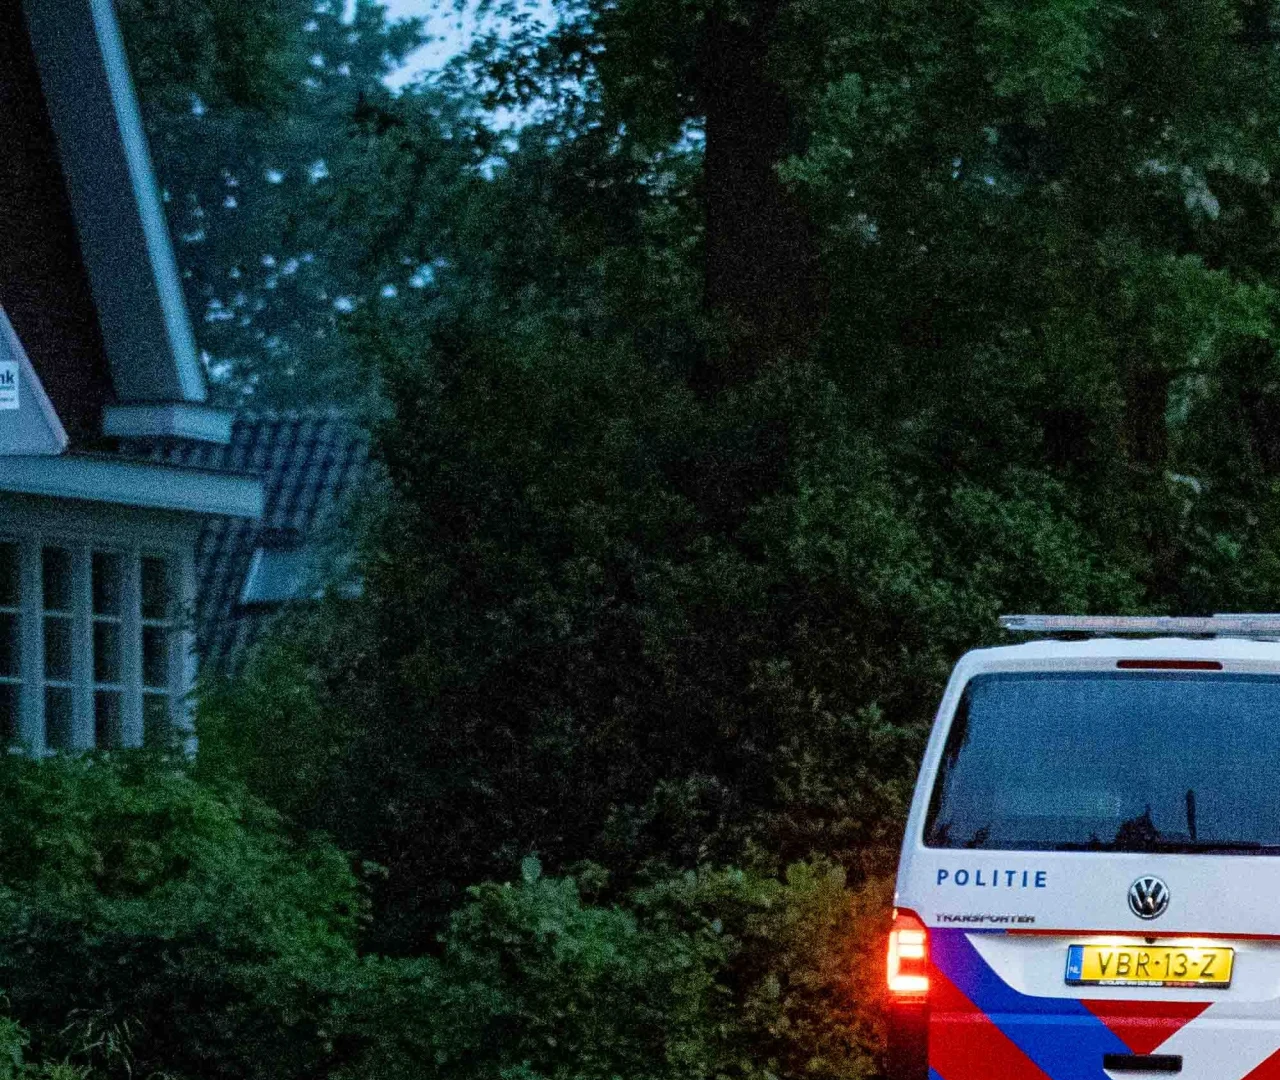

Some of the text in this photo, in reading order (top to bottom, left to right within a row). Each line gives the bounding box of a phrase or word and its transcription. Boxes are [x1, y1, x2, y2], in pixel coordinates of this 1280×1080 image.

[937, 868, 1047, 888] POLITIE
[936, 912, 1036, 924] TRANSPORTER
[1098, 951, 1217, 978] VBR-13-Z
